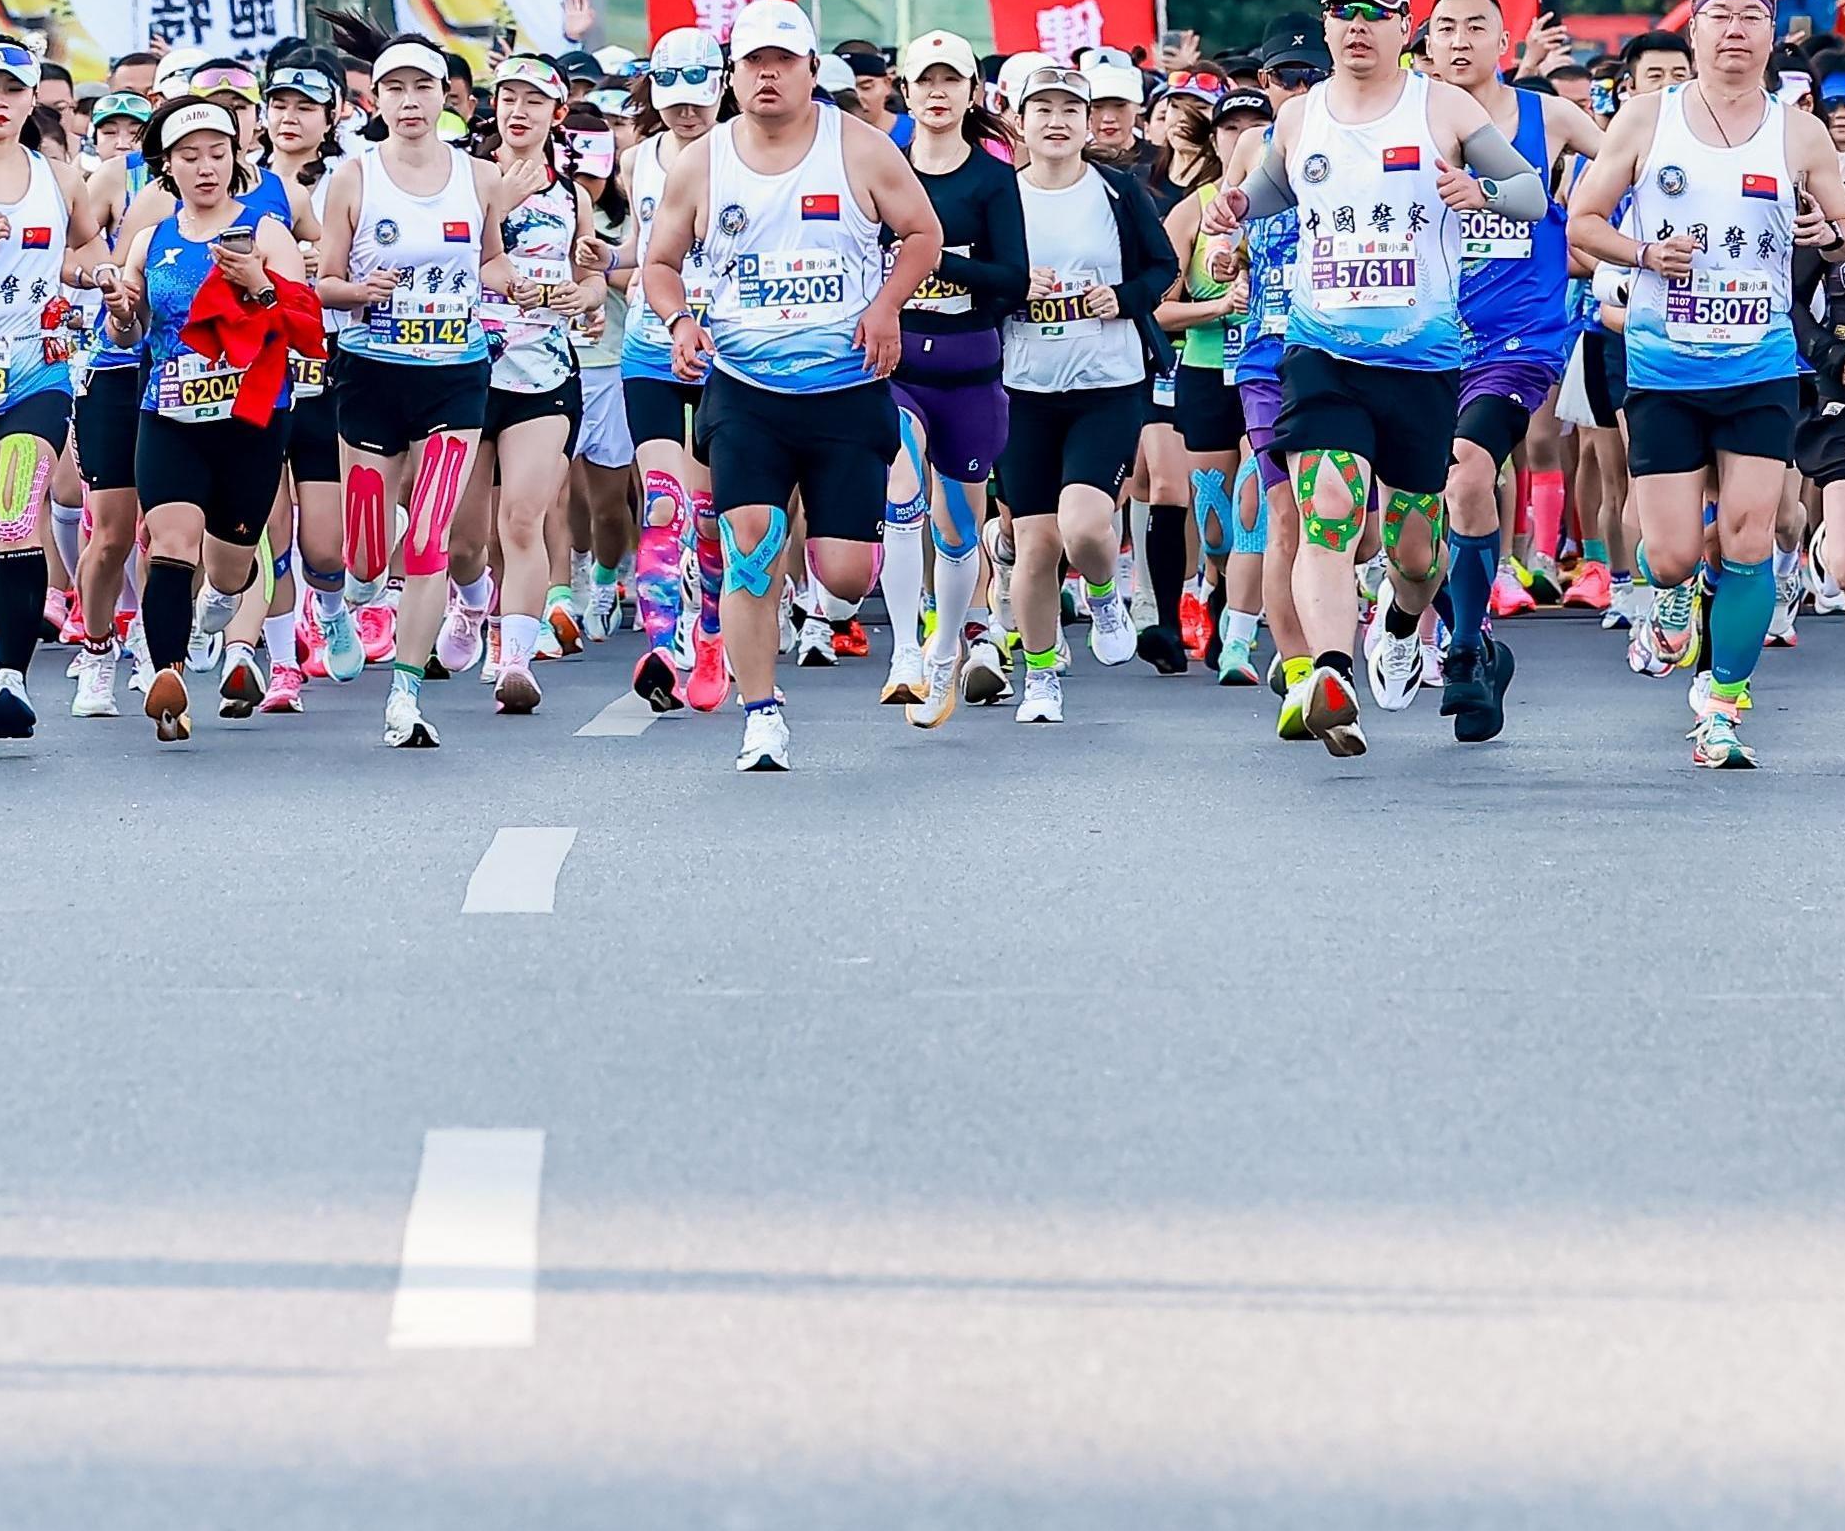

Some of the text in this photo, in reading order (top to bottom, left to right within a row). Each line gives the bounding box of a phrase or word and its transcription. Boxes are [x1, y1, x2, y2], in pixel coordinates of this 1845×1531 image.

[1307, 201, 1431, 238] 中國警察
[1320, 240, 1332, 256] D
[744, 257, 756, 273] D
[1336, 261, 1411, 288] 57611
[1270, 270, 1281, 285] D
[764, 278, 841, 306] 22903
[1695, 298, 1769, 325] 58078
[396, 318, 467, 345] 35142
[1227, 329, 1239, 343] D
[165, 361, 177, 376] D
